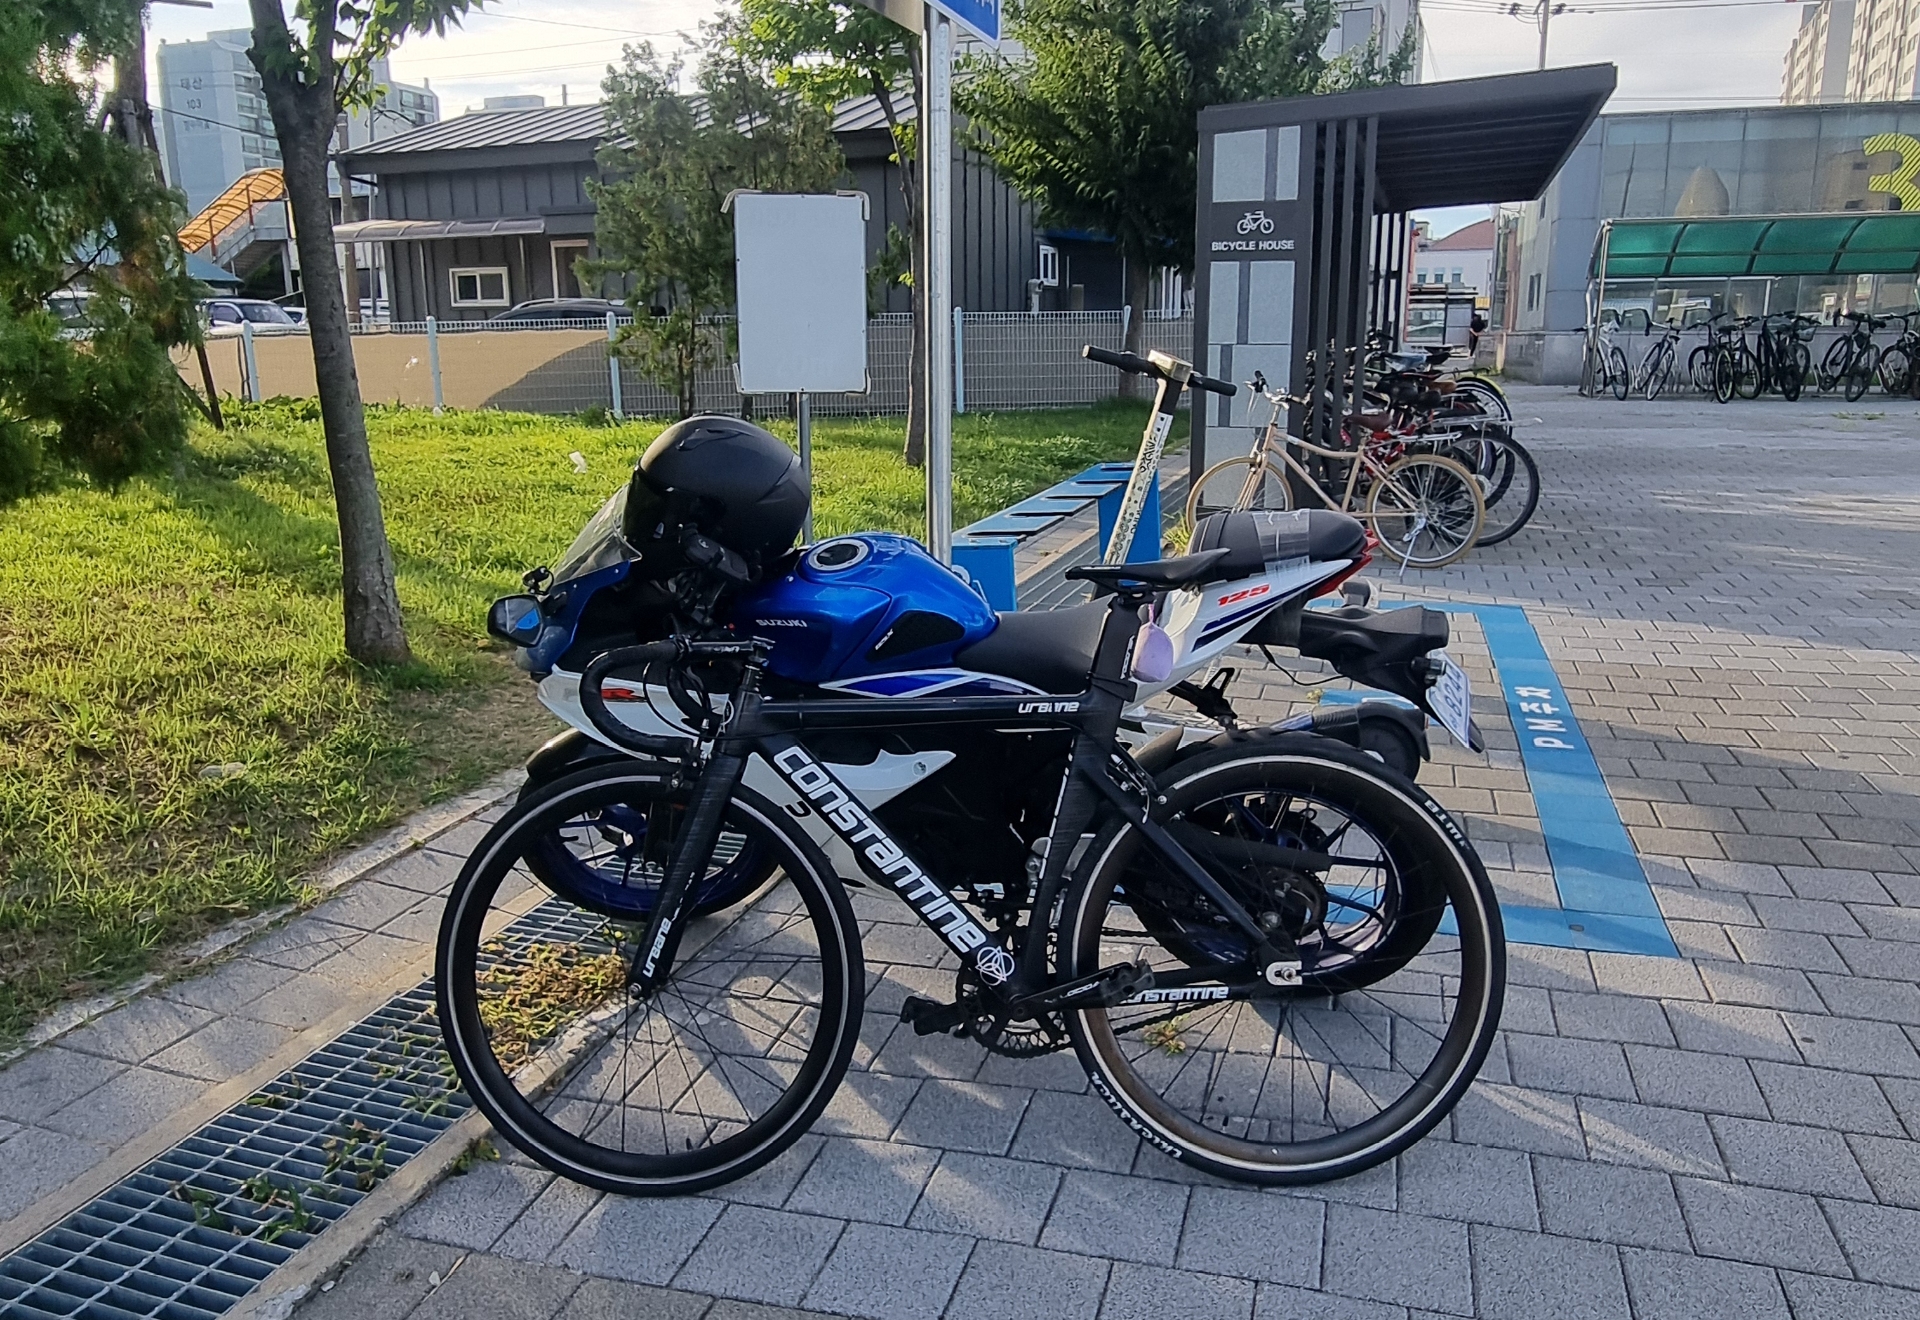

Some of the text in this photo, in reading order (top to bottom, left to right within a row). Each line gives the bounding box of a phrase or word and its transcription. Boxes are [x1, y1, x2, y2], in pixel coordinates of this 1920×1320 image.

[1862, 132, 1920, 211] 3
[1211, 240, 1295, 251] BICYCLE HOUSE
[1218, 584, 1271, 607] 125
[755, 619, 808, 628] SUZUKI
